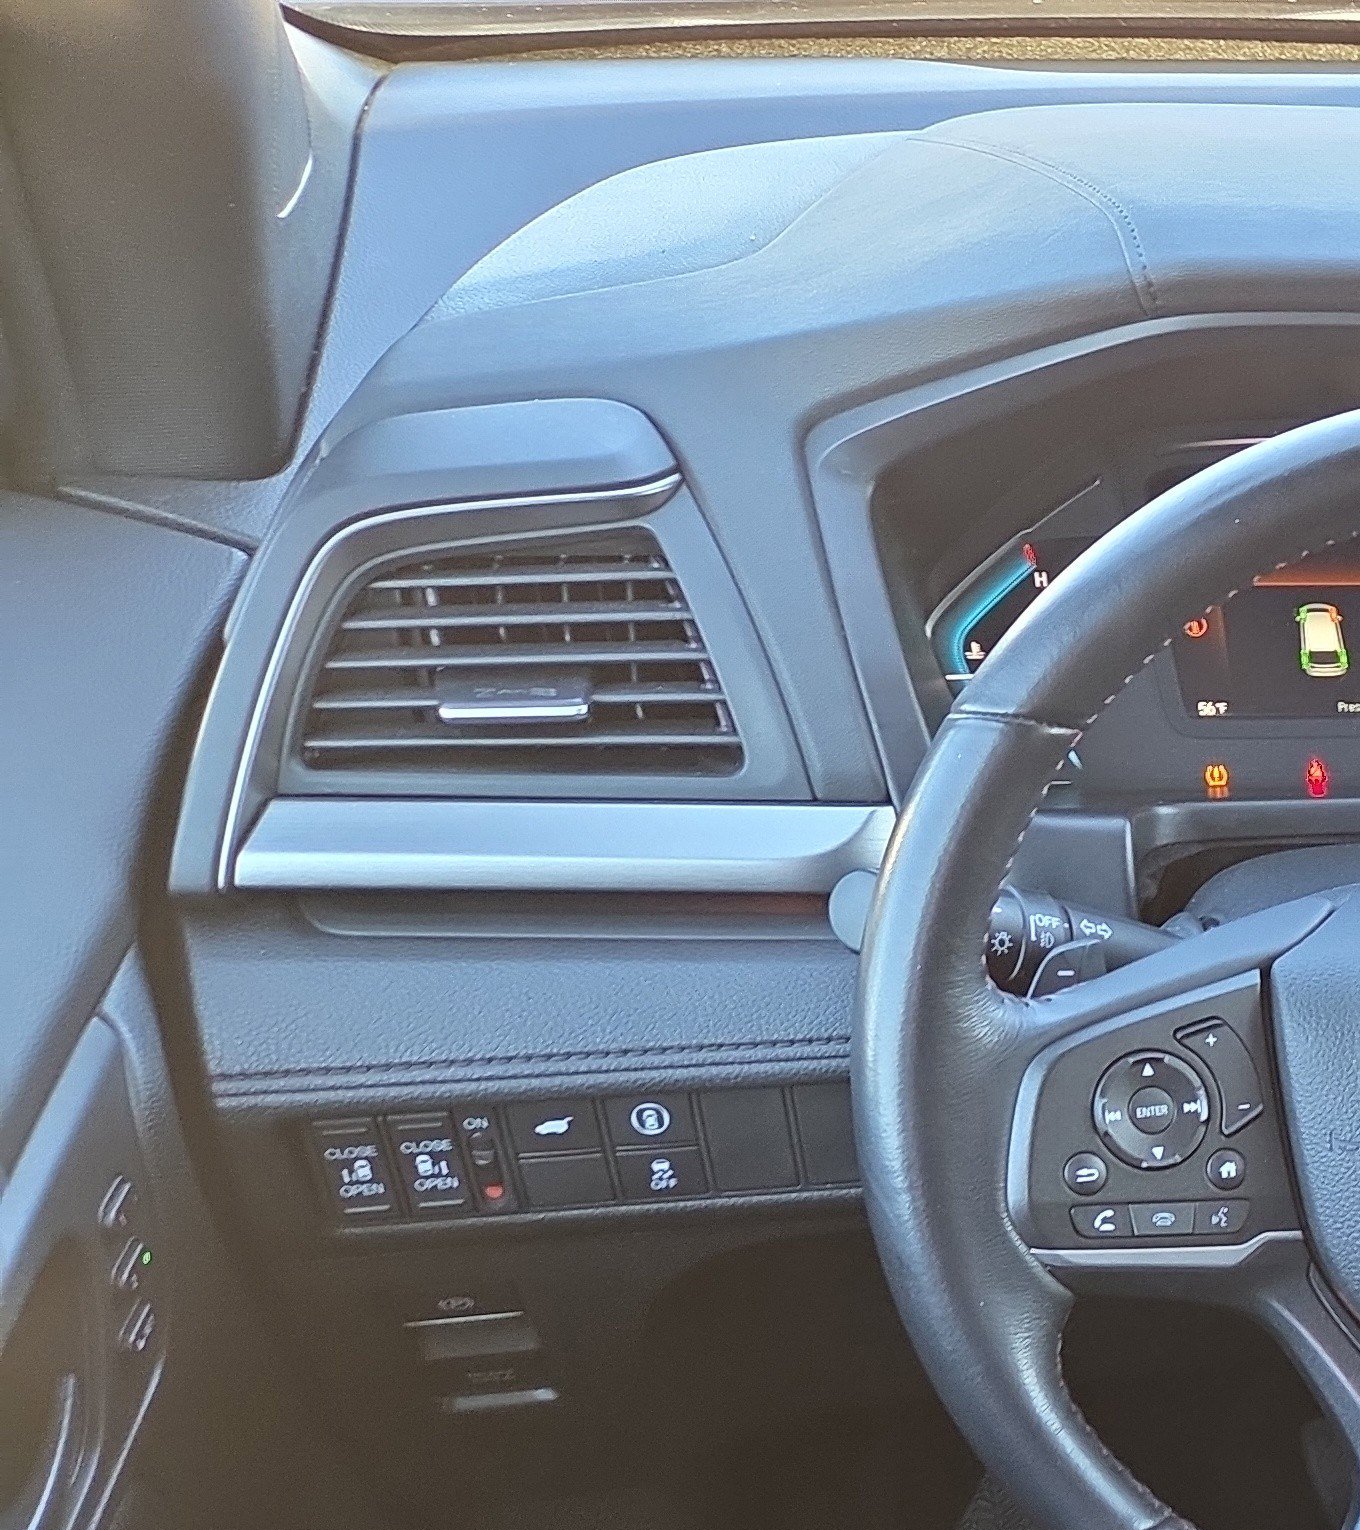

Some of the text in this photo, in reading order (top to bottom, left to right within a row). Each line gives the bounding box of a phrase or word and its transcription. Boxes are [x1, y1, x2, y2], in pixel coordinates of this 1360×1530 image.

[1034, 571, 1048, 588] H
[1035, 914, 1060, 928] OFF
[1136, 1105, 1168, 1118] ENTER
[463, 1117, 489, 1130] ON
[324, 1145, 378, 1160] CLOSE
[400, 1139, 452, 1154] CLOSE
[339, 1183, 385, 1198] OPEN
[414, 1177, 459, 1191] OPEN
